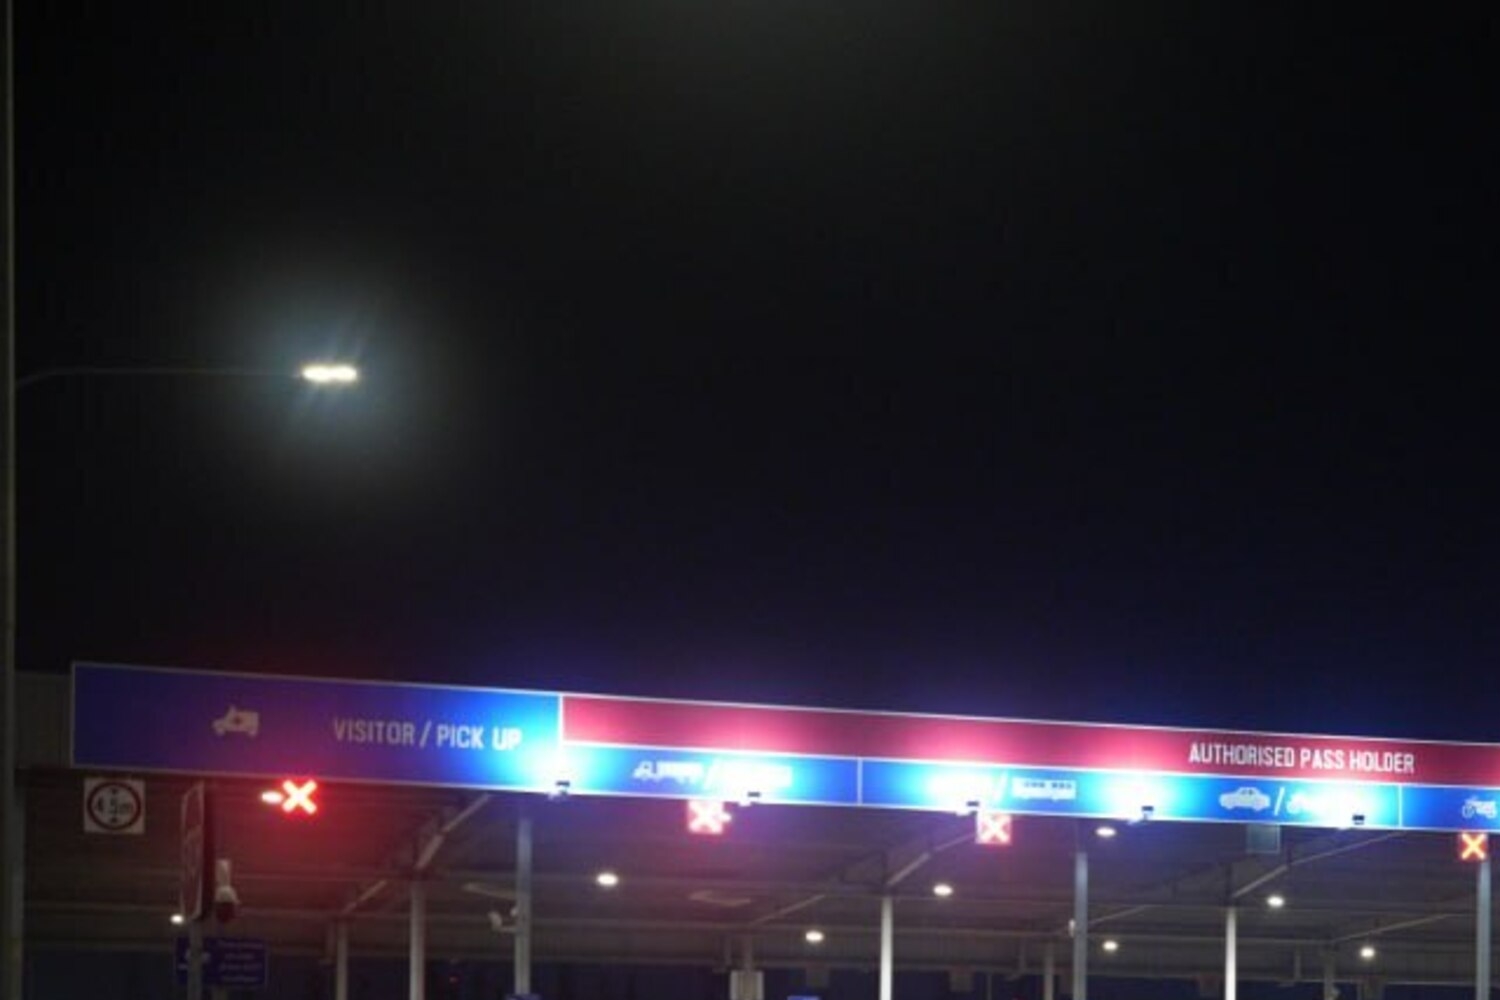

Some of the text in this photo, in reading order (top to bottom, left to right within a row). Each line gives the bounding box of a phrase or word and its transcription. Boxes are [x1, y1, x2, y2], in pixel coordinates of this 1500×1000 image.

[334, 717, 415, 745] VISITOR
[436, 724, 484, 749] PICK
[491, 727, 523, 750] UP
[1188, 742, 1415, 774] AUTHORISED PASS HOLDER
